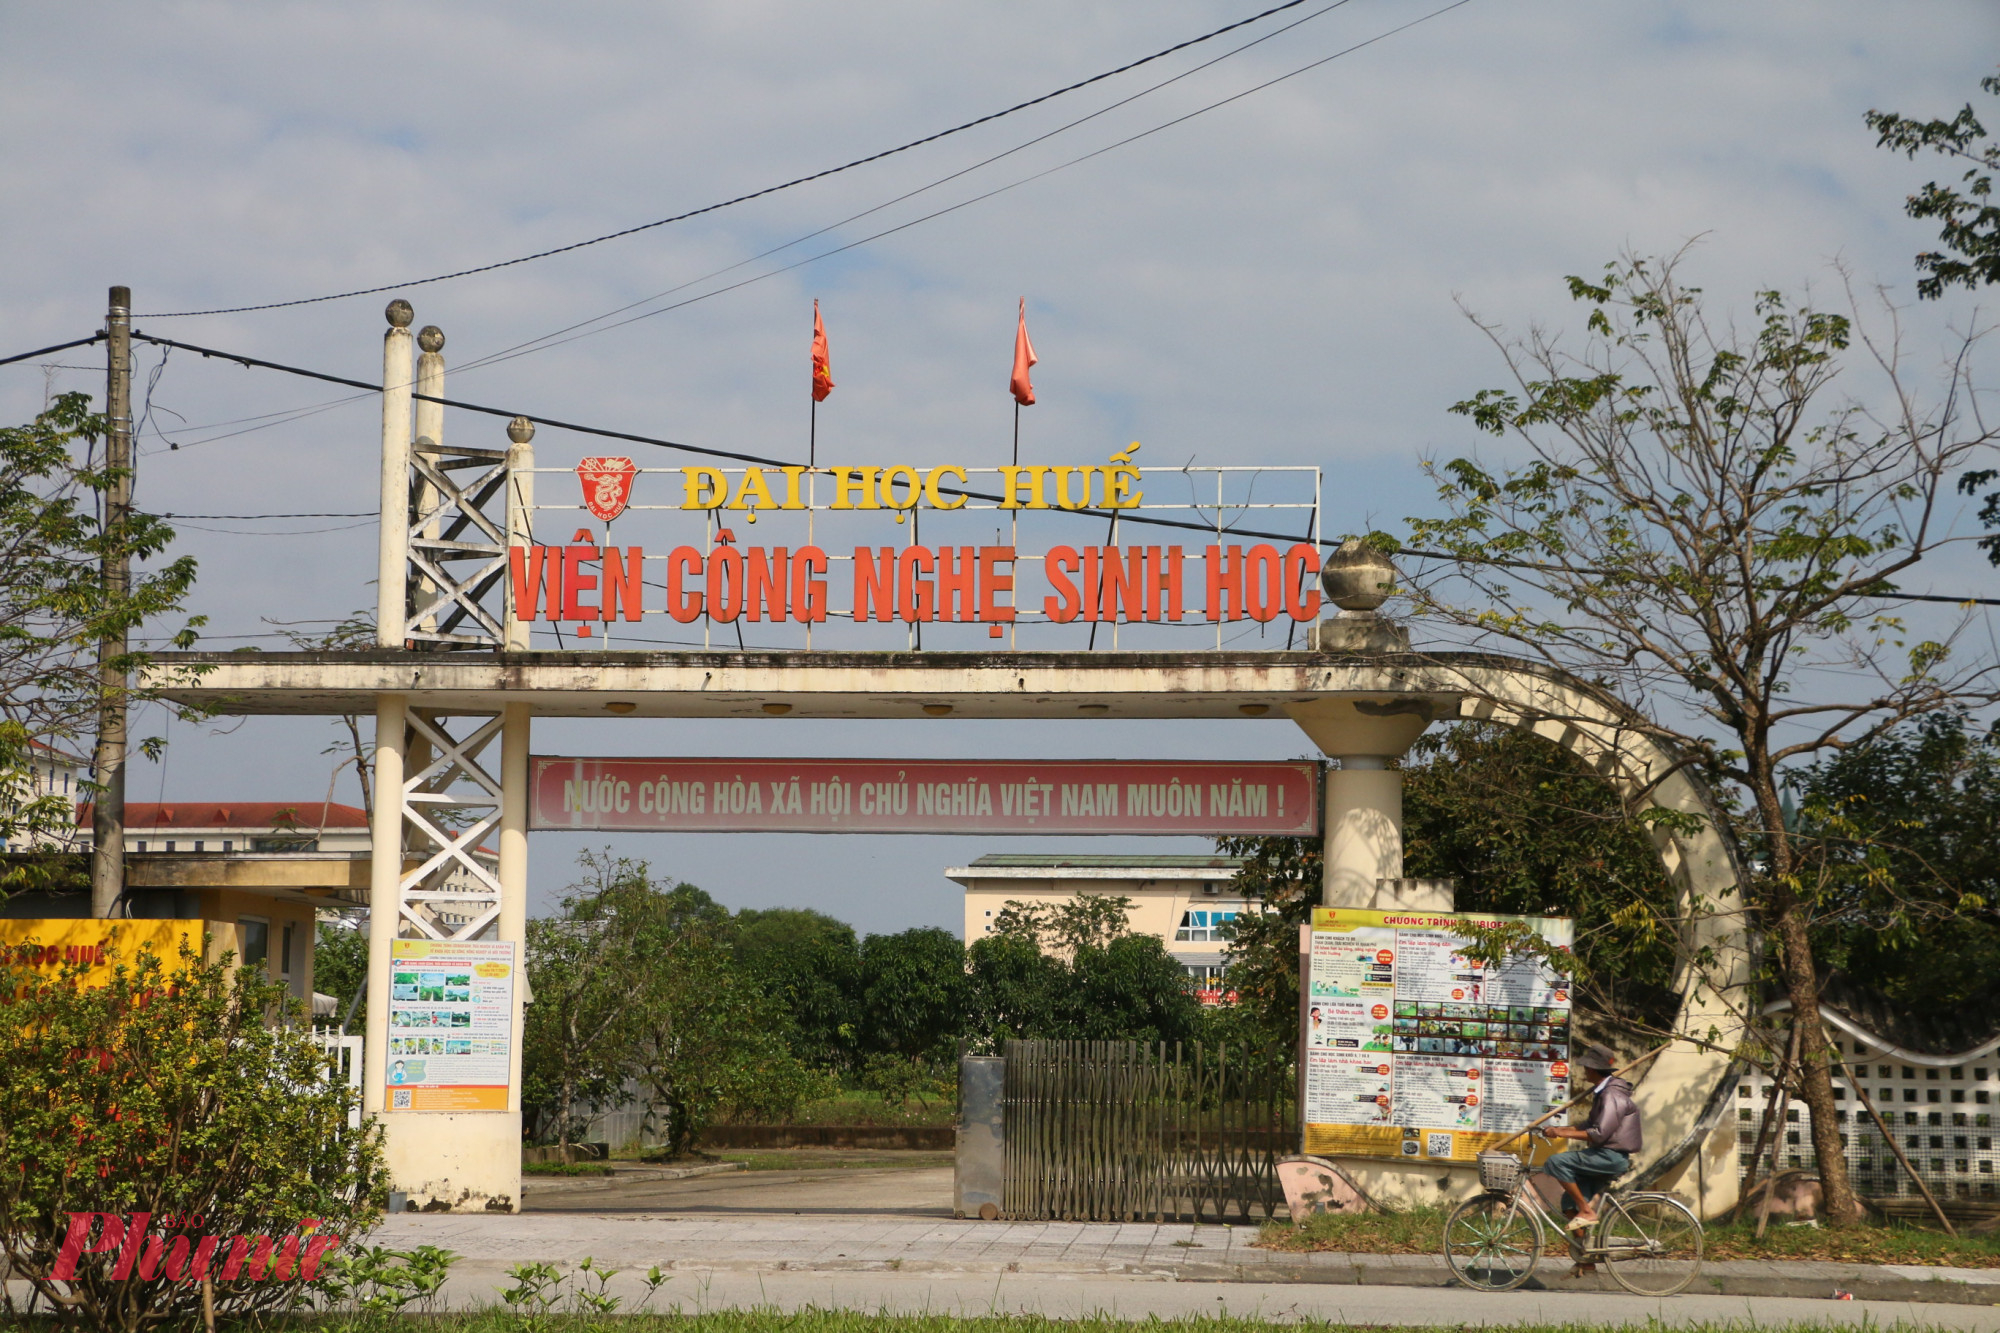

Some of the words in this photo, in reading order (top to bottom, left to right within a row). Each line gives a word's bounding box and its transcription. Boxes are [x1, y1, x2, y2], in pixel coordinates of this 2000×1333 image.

[681, 466, 805, 524] ĐẠI
[831, 464, 969, 524] HỌC
[999, 441, 1143, 509] HUẾ
[510, 528, 642, 638] VIỆN
[667, 528, 827, 624] CÔNG
[1044, 545, 1182, 624] SINH
[563, 773, 630, 813] NƯỚC
[638, 774, 705, 822] CỘNG
[713, 774, 762, 814] HÒA
[770, 775, 803, 815] XÃ
[810, 775, 851, 822] HỘI
[859, 770, 909, 816] CHỦ
[916, 776, 993, 816] NGHĨA
[1000, 776, 1054, 824] VIỆT
[1061, 783, 1119, 817] NAM
[1127, 776, 1202, 817] MUÔN
[1209, 777, 1268, 817] NĂM
